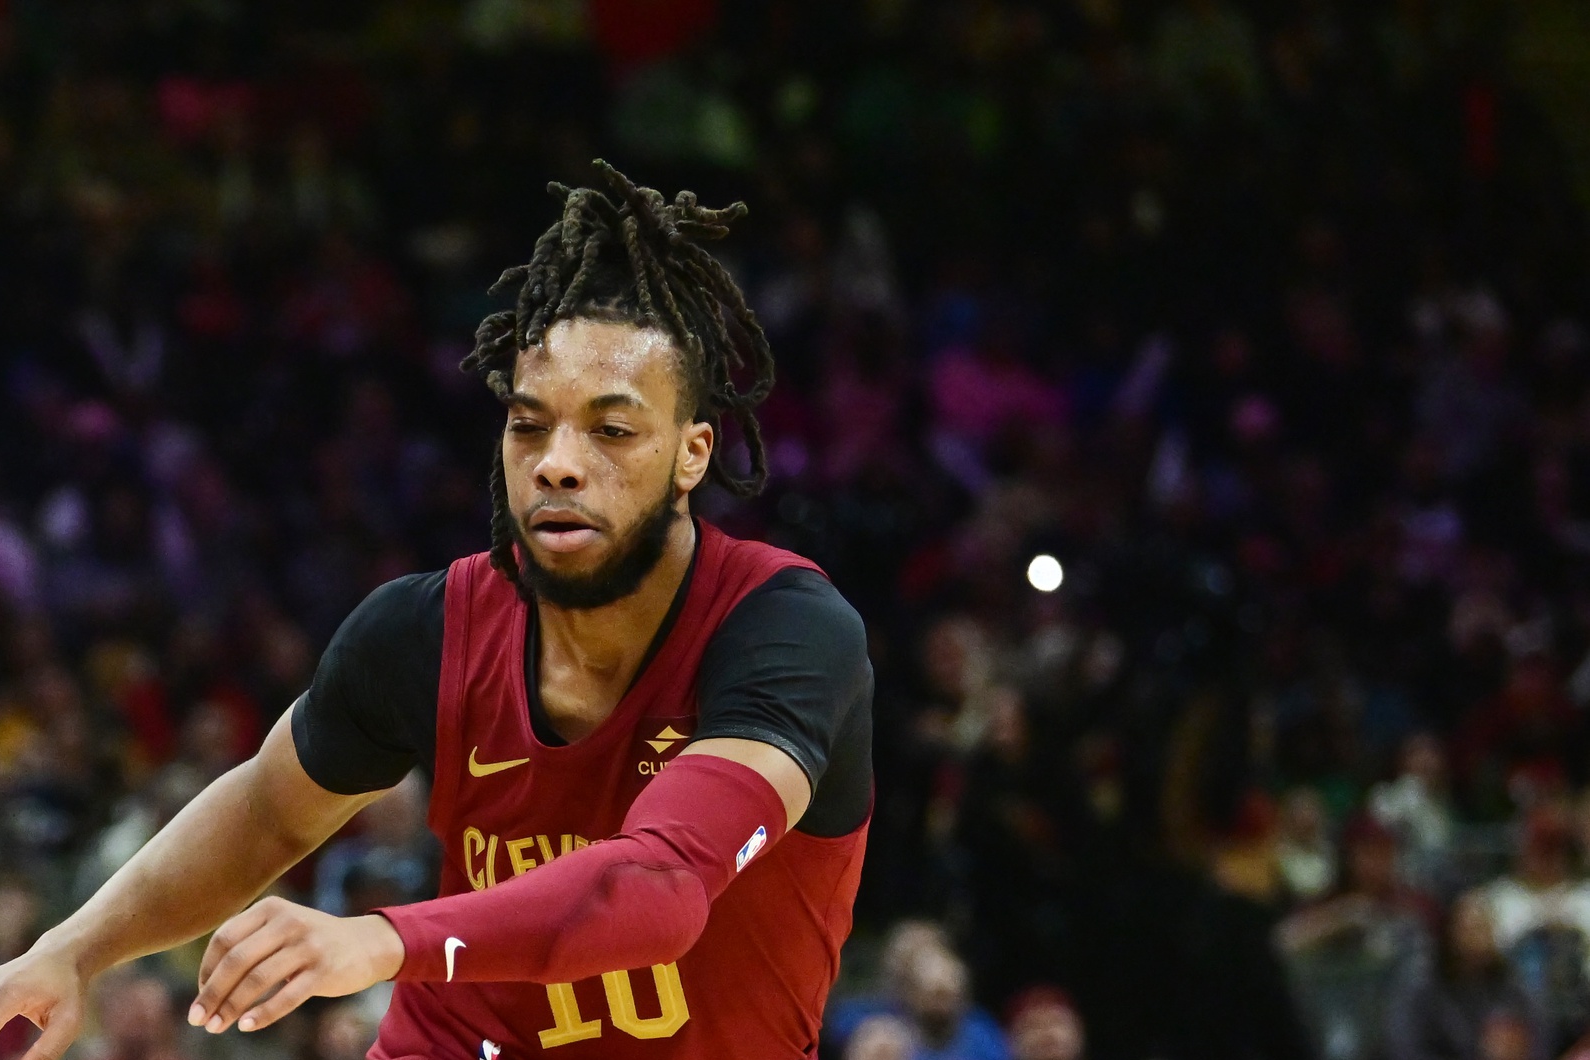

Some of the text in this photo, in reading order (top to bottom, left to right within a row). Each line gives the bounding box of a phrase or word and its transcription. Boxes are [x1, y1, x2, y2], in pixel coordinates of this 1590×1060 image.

[638, 761, 671, 775] CLI
[463, 826, 605, 892] CLEV
[538, 961, 690, 1049] 10
